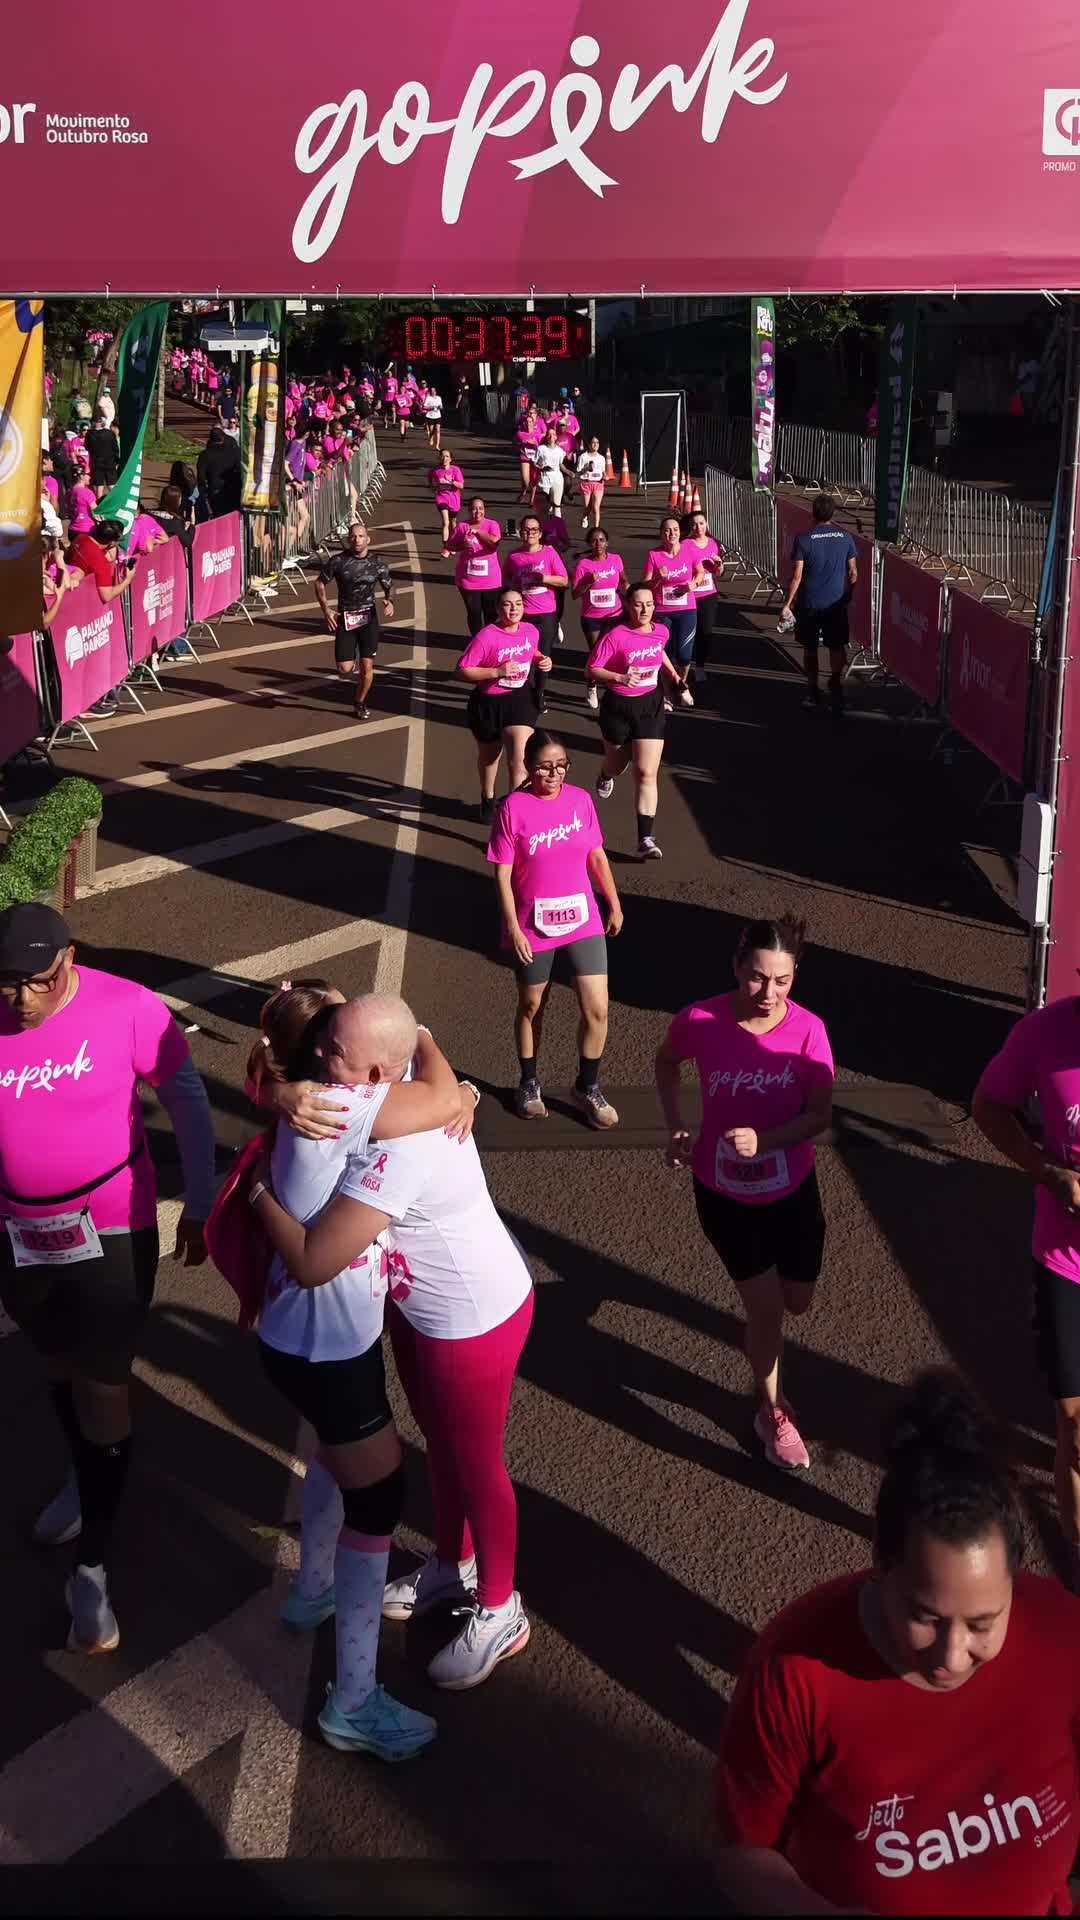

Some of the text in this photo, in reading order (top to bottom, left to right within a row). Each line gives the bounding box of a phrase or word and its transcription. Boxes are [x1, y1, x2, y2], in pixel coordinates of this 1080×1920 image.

[45, 113, 130, 128] Movimento
[46, 129, 148, 143] Outubro Rosa
[292, 0, 788, 263] gopink
[1043, 161, 1076, 172] PROMO
[405, 315, 567, 357] 00:37:39
[81, 610, 113, 642] PALHANO
[529, 810, 583, 856] gopink
[548, 909, 576, 922] 1113
[0, 1040, 94, 1099] opink
[709, 1060, 797, 1096] gopink
[360, 1176, 381, 1193] ROSA
[855, 1794, 914, 1840] jeito
[875, 1793, 1043, 1878] Sabin
